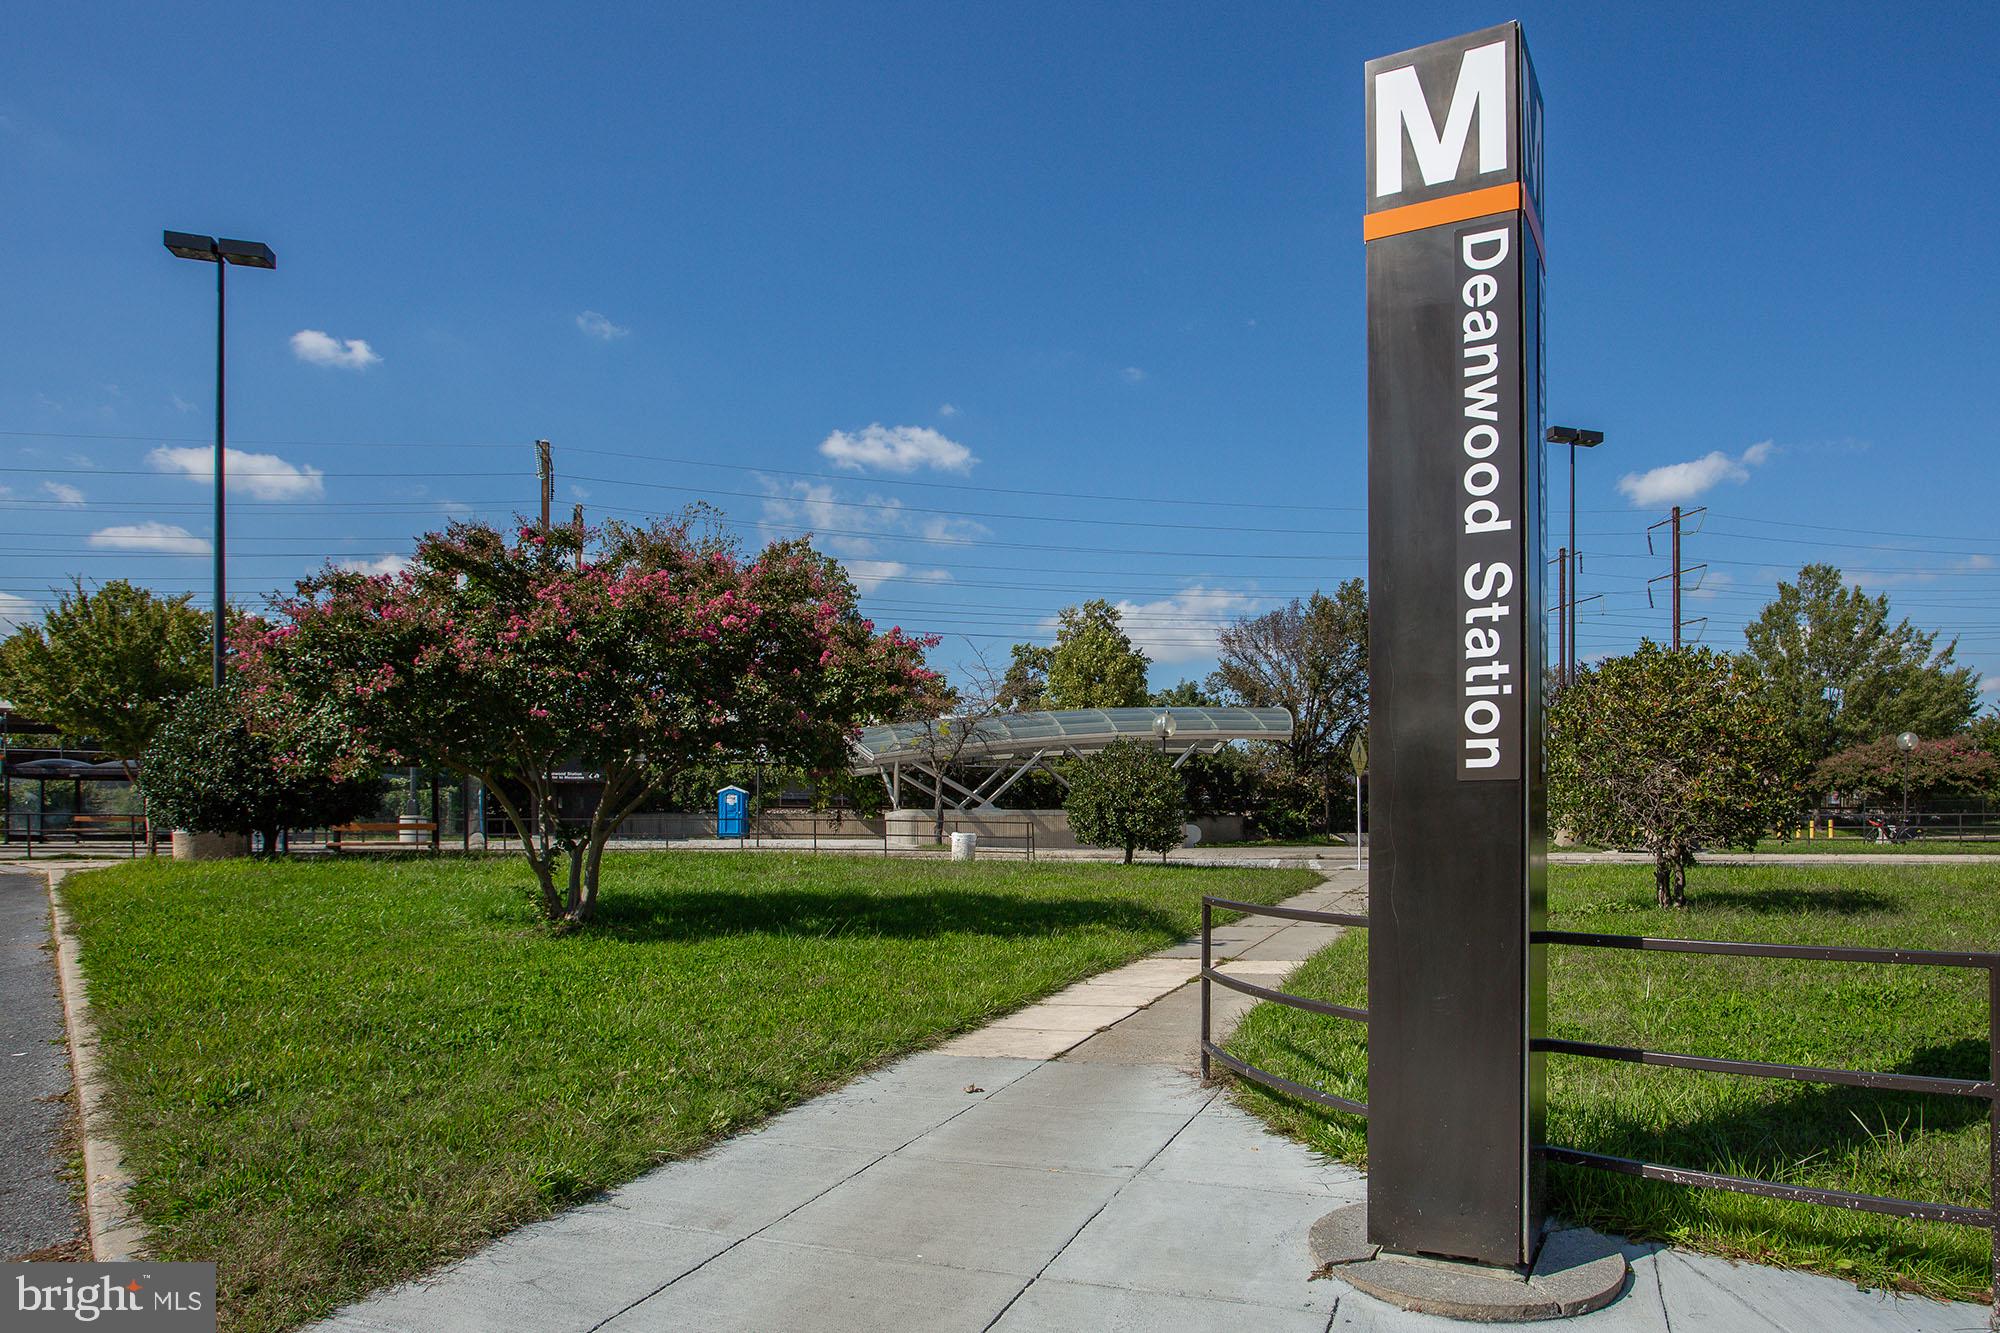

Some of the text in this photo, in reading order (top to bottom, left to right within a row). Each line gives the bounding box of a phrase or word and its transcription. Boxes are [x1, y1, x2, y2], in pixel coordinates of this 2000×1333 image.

[1375, 40, 1507, 198] M
[1521, 46, 1544, 223] M
[1462, 227, 1513, 769] Deanwood Station
